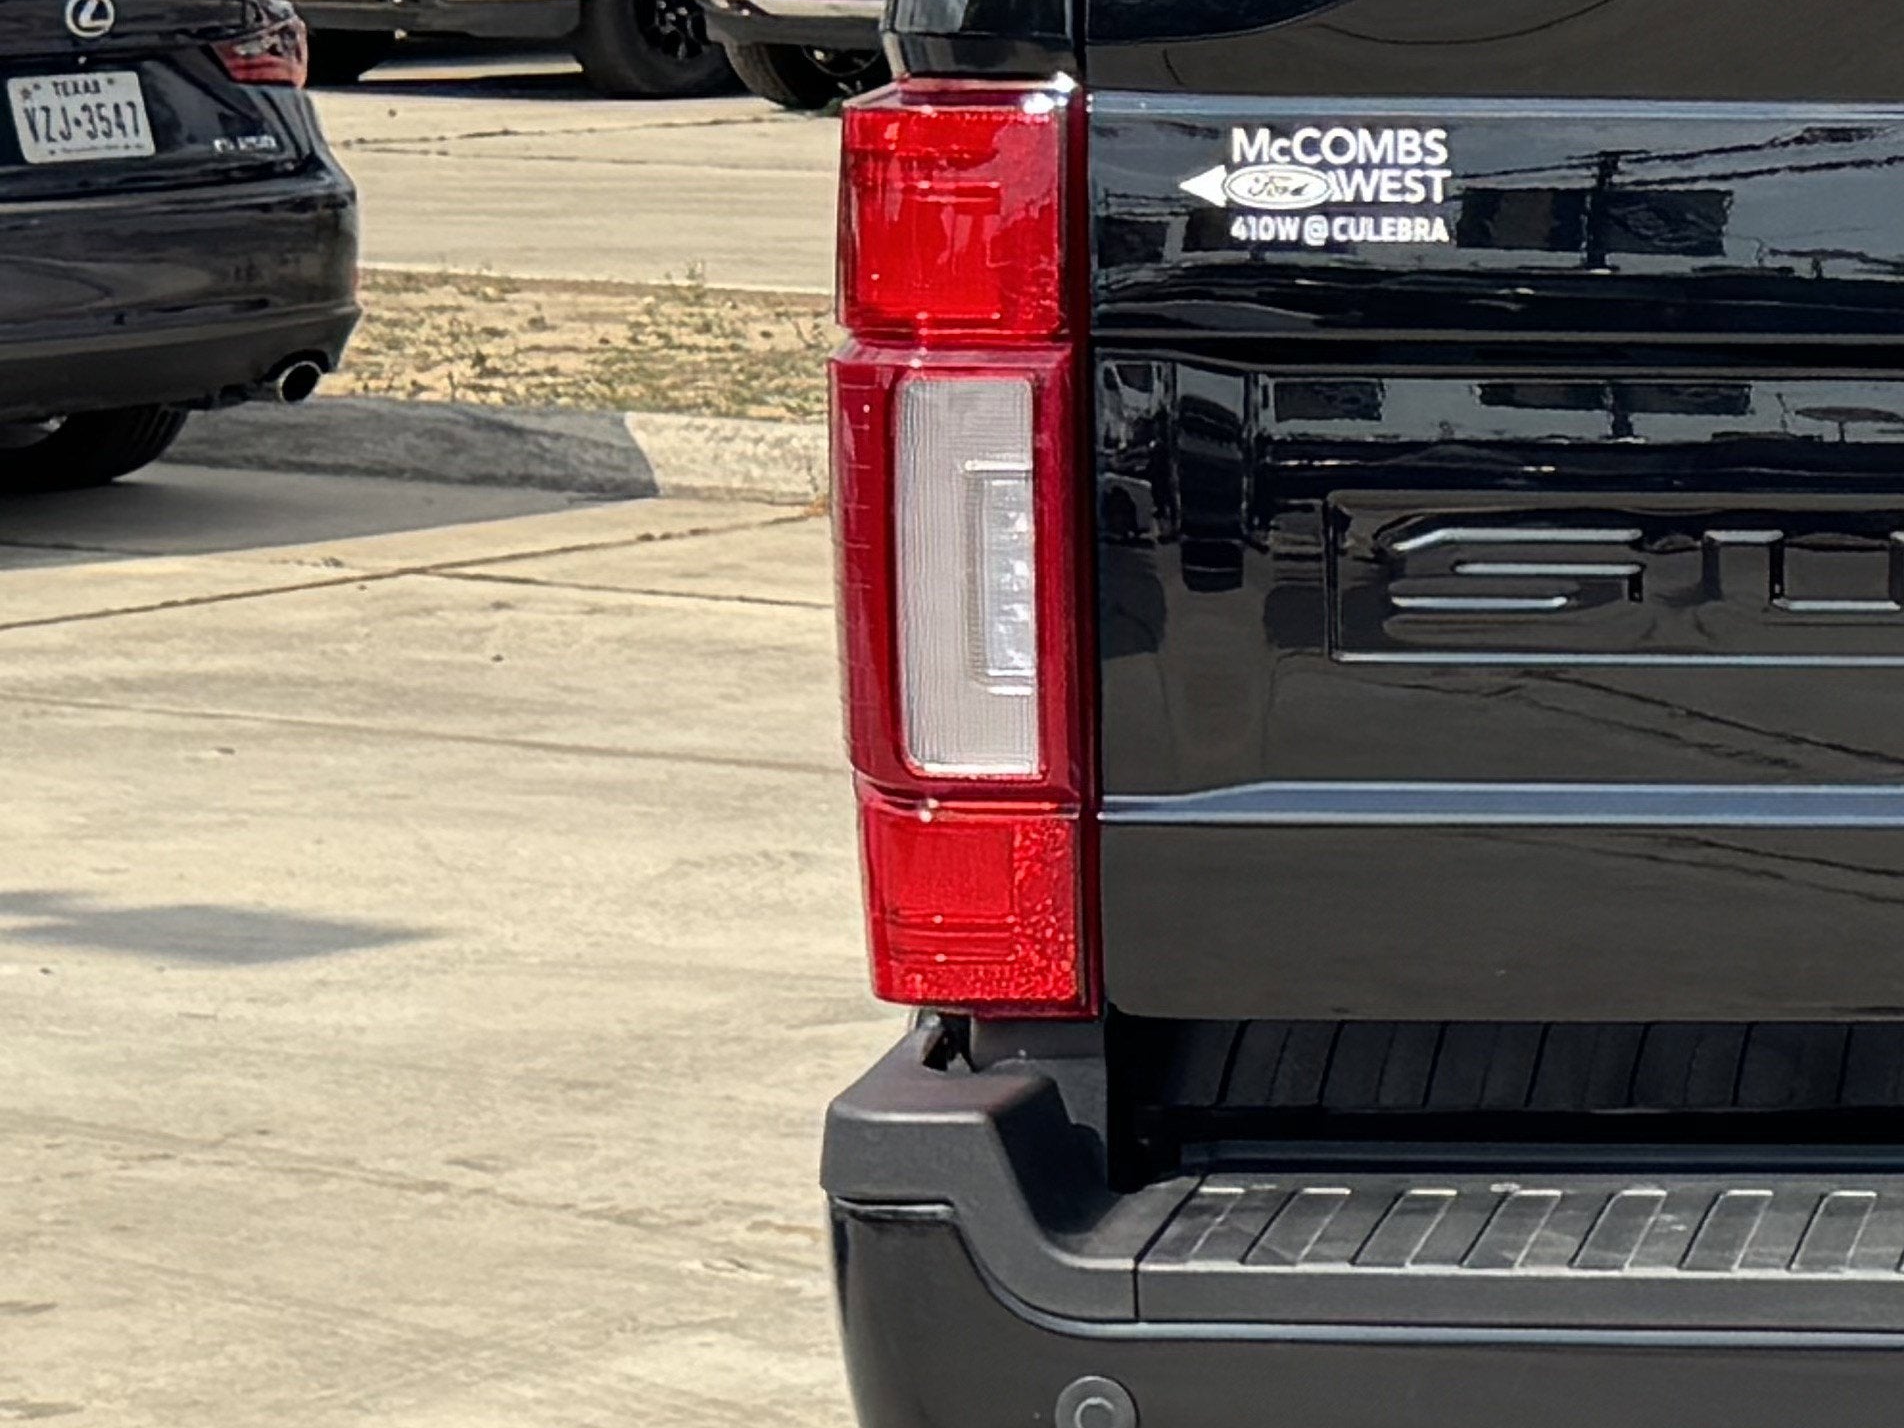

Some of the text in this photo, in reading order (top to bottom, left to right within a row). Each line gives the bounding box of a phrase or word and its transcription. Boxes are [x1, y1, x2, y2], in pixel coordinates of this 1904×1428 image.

[1231, 126, 1449, 165] McCOMBS
[1336, 168, 1452, 204] WEST
[1332, 216, 1450, 243] CULEBRA
